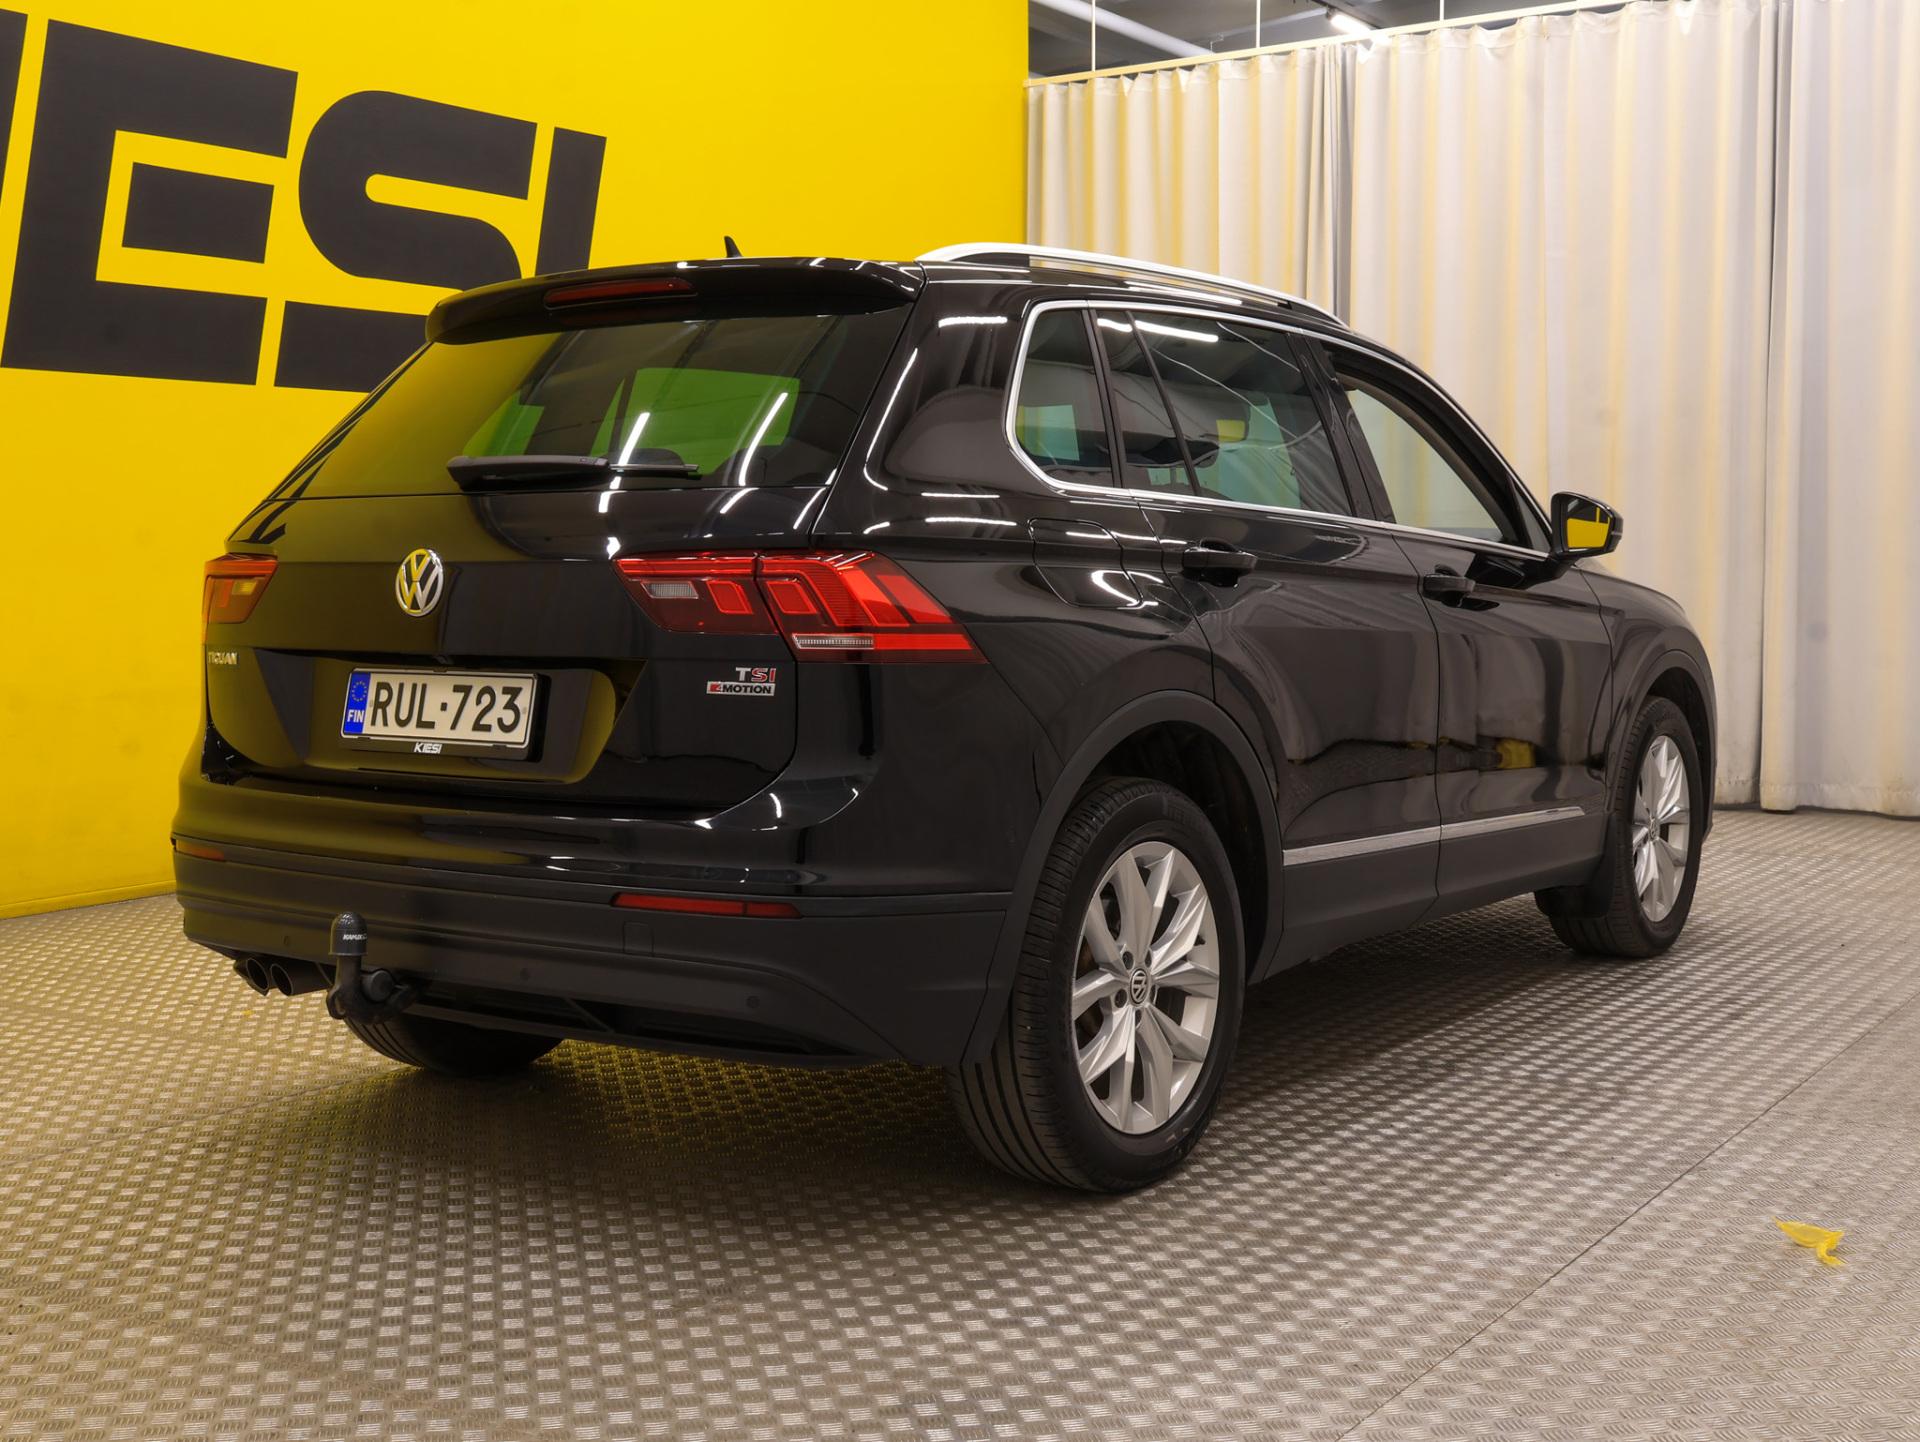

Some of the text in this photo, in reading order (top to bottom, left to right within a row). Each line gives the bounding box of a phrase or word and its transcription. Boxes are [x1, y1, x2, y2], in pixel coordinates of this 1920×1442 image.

[0, 8, 607, 393] ESI
[395, 548, 443, 616] VW
[735, 666, 777, 683] TSI
[709, 682, 773, 695] 4MOTION
[346, 709, 365, 723] FIN
[370, 681, 524, 734] RUL-723
[413, 741, 443, 755] KIESI
